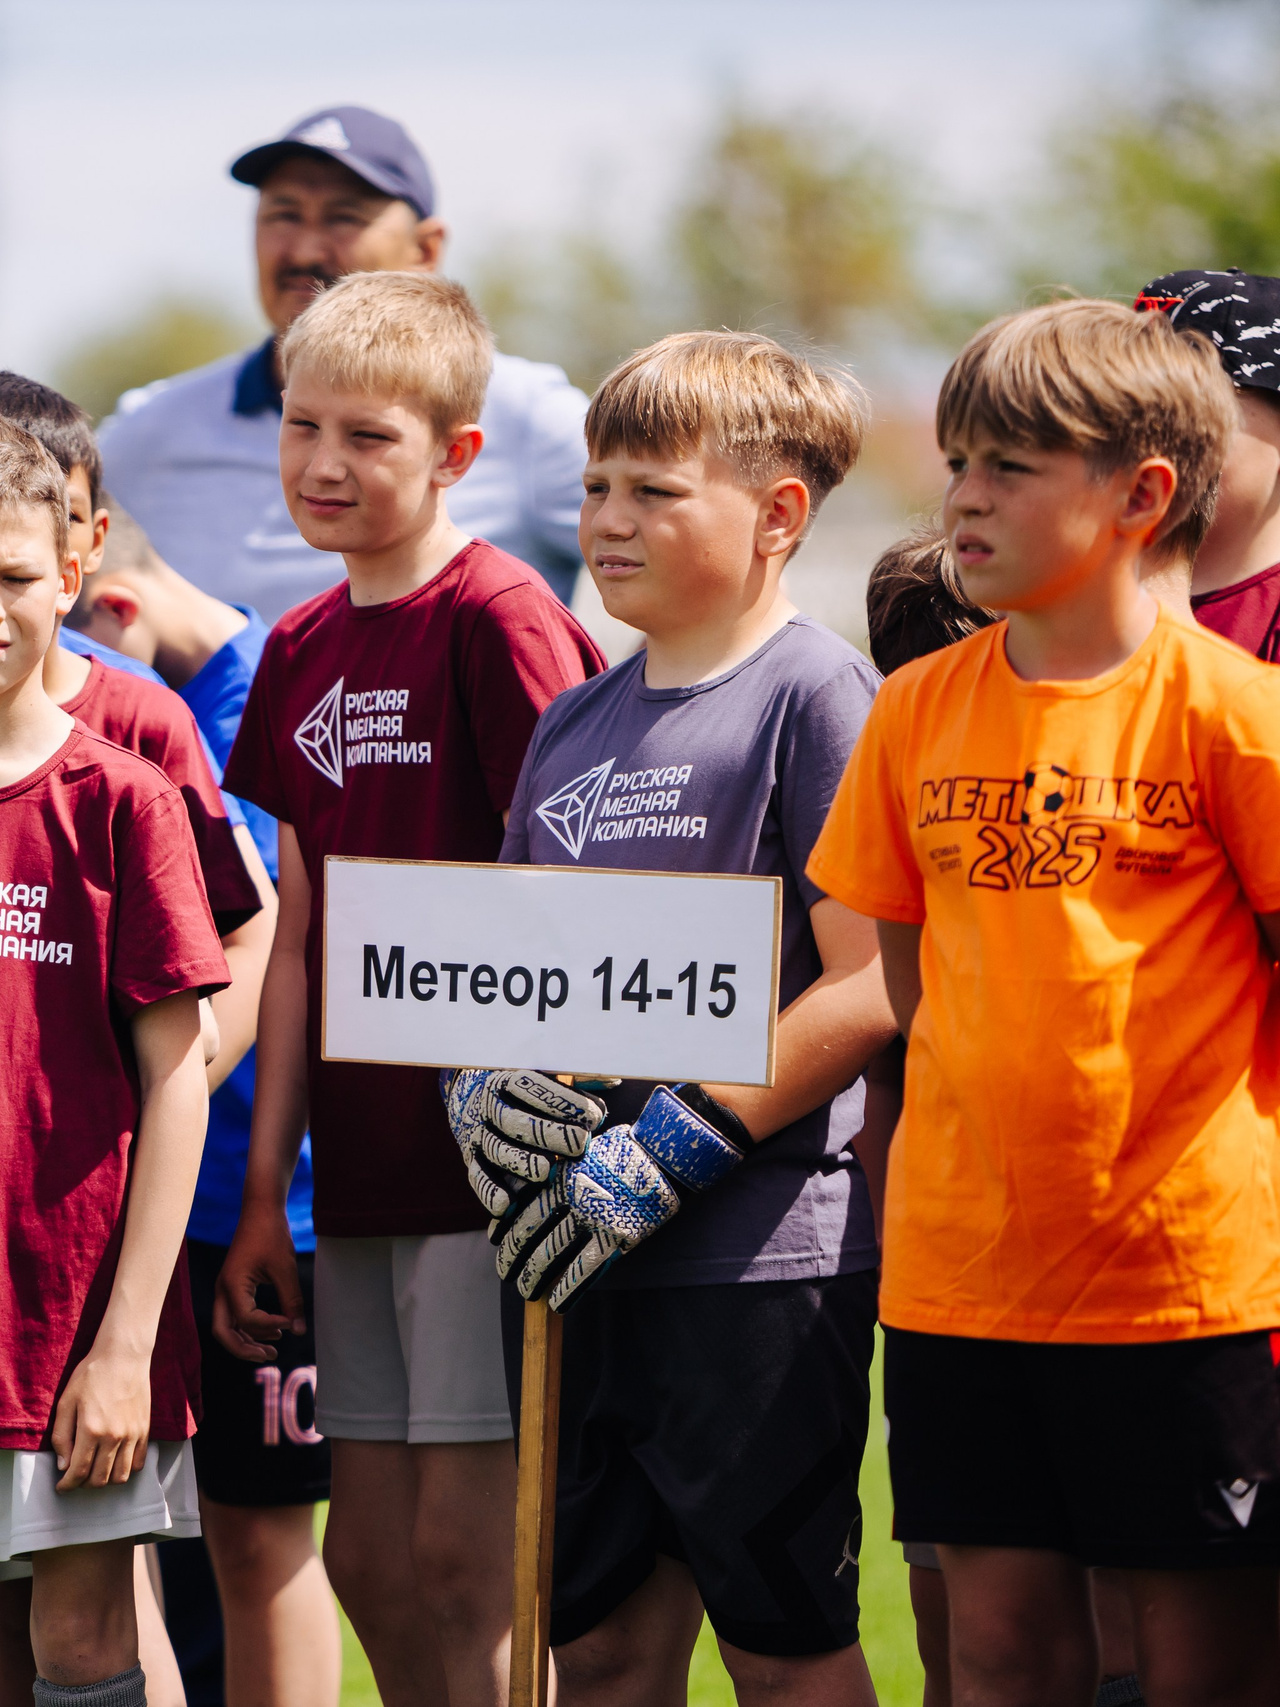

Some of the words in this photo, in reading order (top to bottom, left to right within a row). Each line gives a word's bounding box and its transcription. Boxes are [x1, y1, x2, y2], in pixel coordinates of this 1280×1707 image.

[345, 689, 409, 715] РУССКАЯ
[346, 715, 403, 741] МЕДНАЯ
[608, 764, 693, 794] РУССКАЯ
[599, 789, 682, 818] МЕДНАЯ
[591, 815, 708, 842] КОМПАНИЯ
[969, 822, 1106, 891] 2025
[362, 943, 570, 1022] Метеор
[592, 956, 738, 1019] 14-15
[255, 1365, 325, 1446] 10
